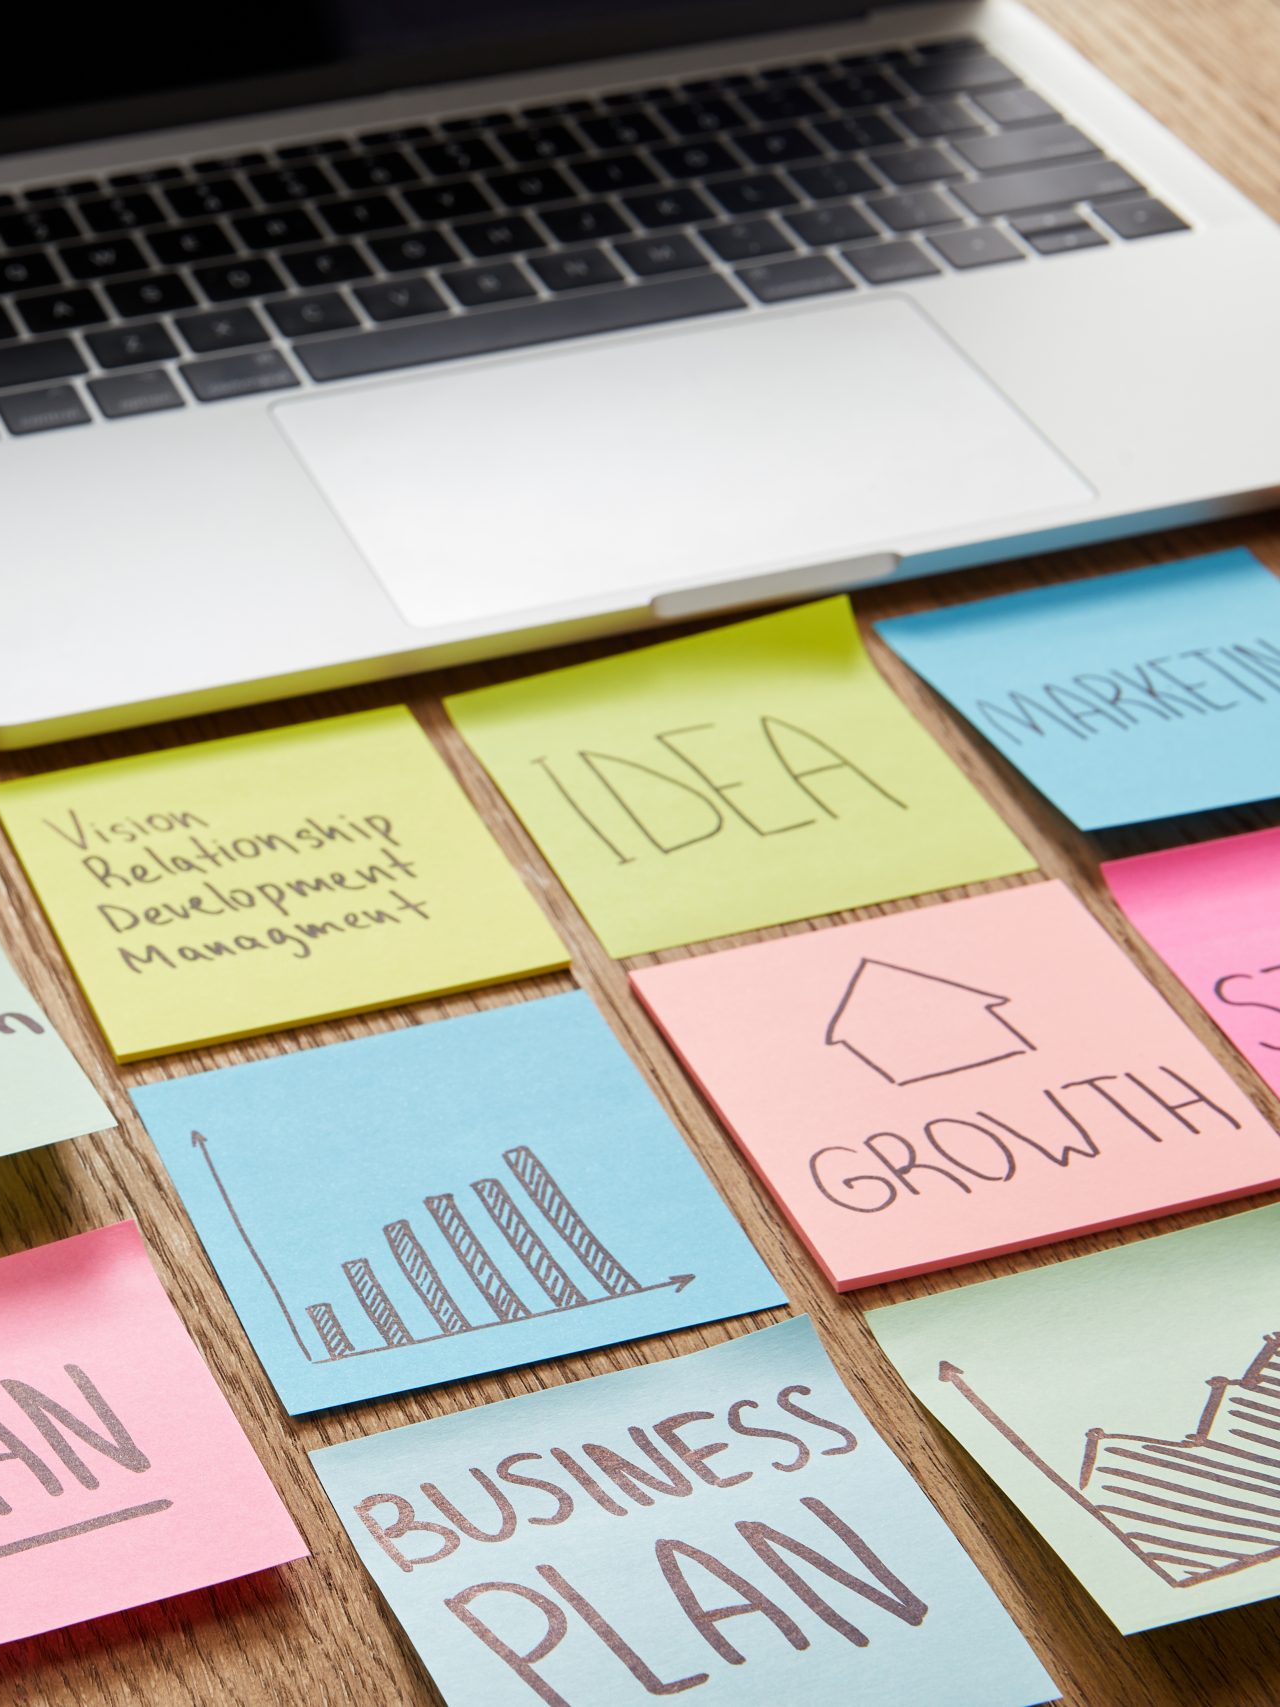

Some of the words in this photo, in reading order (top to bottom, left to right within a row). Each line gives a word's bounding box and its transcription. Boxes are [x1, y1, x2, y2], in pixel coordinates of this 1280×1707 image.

[42, 807, 211, 852] Vision
[531, 714, 909, 866] IDEA
[81, 809, 404, 891] Relationship
[96, 844, 418, 935] Development
[117, 889, 431, 975] Managment
[1214, 964, 1280, 1052] S
[808, 1064, 1242, 1214] GROWTH
[354, 1384, 859, 1573] BUSINESS
[444, 1495, 929, 1707] PLAN
